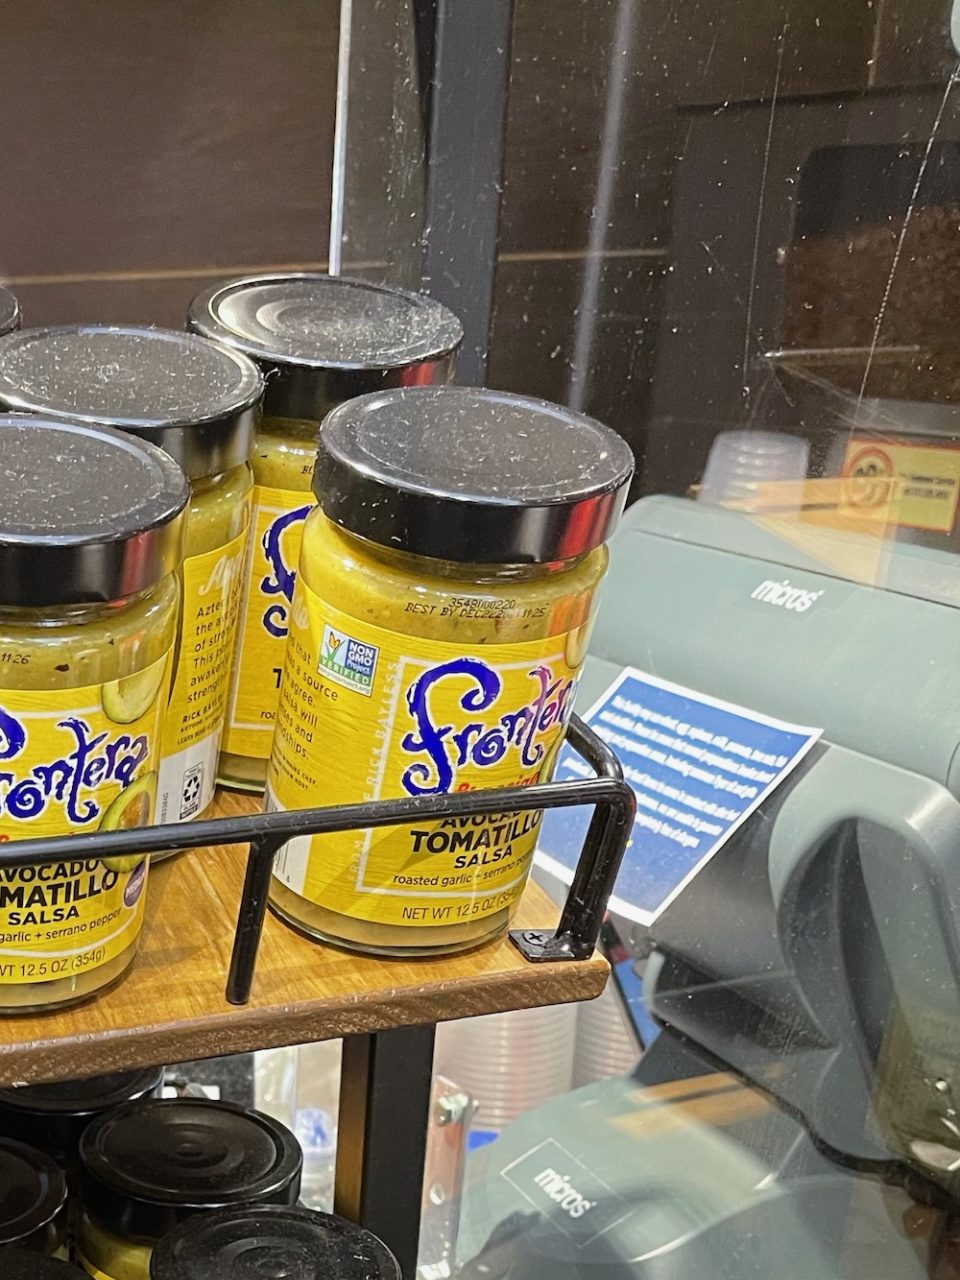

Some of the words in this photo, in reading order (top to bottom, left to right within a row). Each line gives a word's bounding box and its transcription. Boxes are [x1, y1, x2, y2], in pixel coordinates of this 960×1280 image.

[750, 579, 817, 612] micros
[404, 602, 437, 616] BEST
[439, 606, 458, 617] BY
[193, 639, 207, 653] of
[296, 640, 312, 666] that
[348, 640, 374, 660] NON
[193, 651, 214, 670] This
[347, 650, 373, 668] GMO
[320, 656, 370, 686] VERIFIED
[290, 682, 318, 708] agree.
[302, 671, 339, 702] source
[182, 709, 202, 725] RICK
[300, 707, 319, 729] will
[294, 723, 313, 744] and
[410, 808, 540, 855] TOMATILLO
[453, 844, 514, 870] SALSA
[393, 874, 439, 887] roasted
[441, 872, 474, 888] garlic
[8, 905, 81, 927] SALSA
[402, 905, 429, 920] NET
[431, 905, 453, 920] WT
[482, 897, 497, 912] OZ
[46, 922, 88, 940] serrano
[90, 906, 122, 931] pepper
[20, 962, 48, 977] 12.5
[51, 957, 69, 973] OZ
[71, 946, 107, 972] (354g)
[534, 1167, 591, 1218] micros
